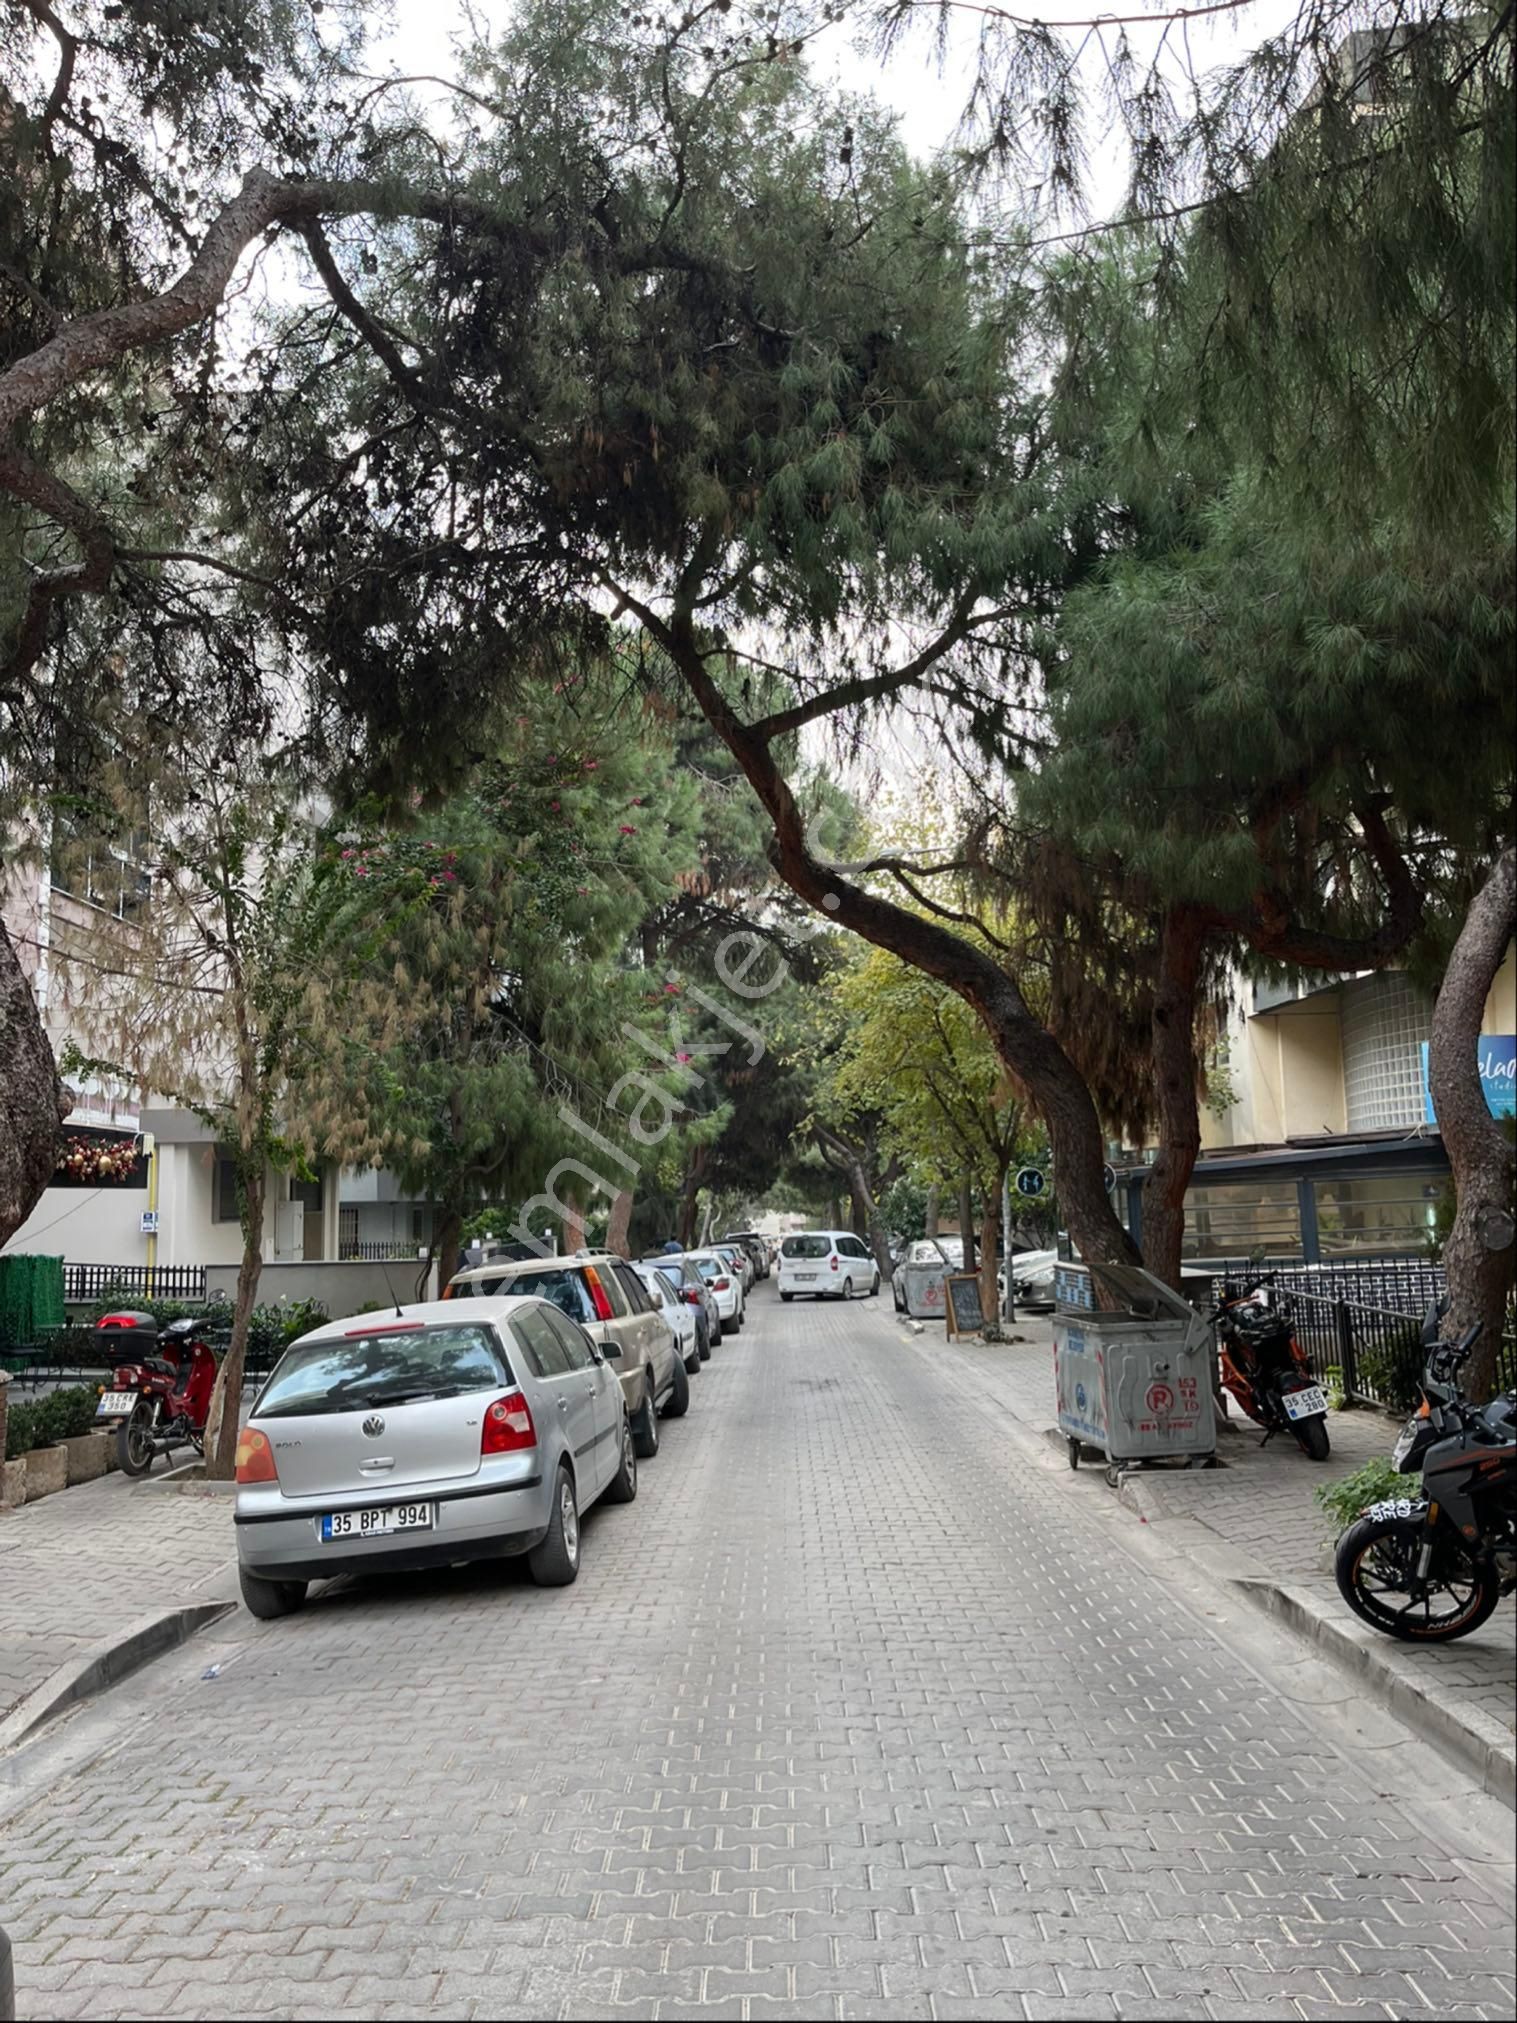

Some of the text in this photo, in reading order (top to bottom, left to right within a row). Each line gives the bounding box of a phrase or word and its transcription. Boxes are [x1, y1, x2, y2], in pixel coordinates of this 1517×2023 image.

[1286, 1397, 1299, 1408] 35
[333, 1514, 352, 1534] 35
[360, 1509, 389, 1530] BPT
[398, 1504, 428, 1525] 994
